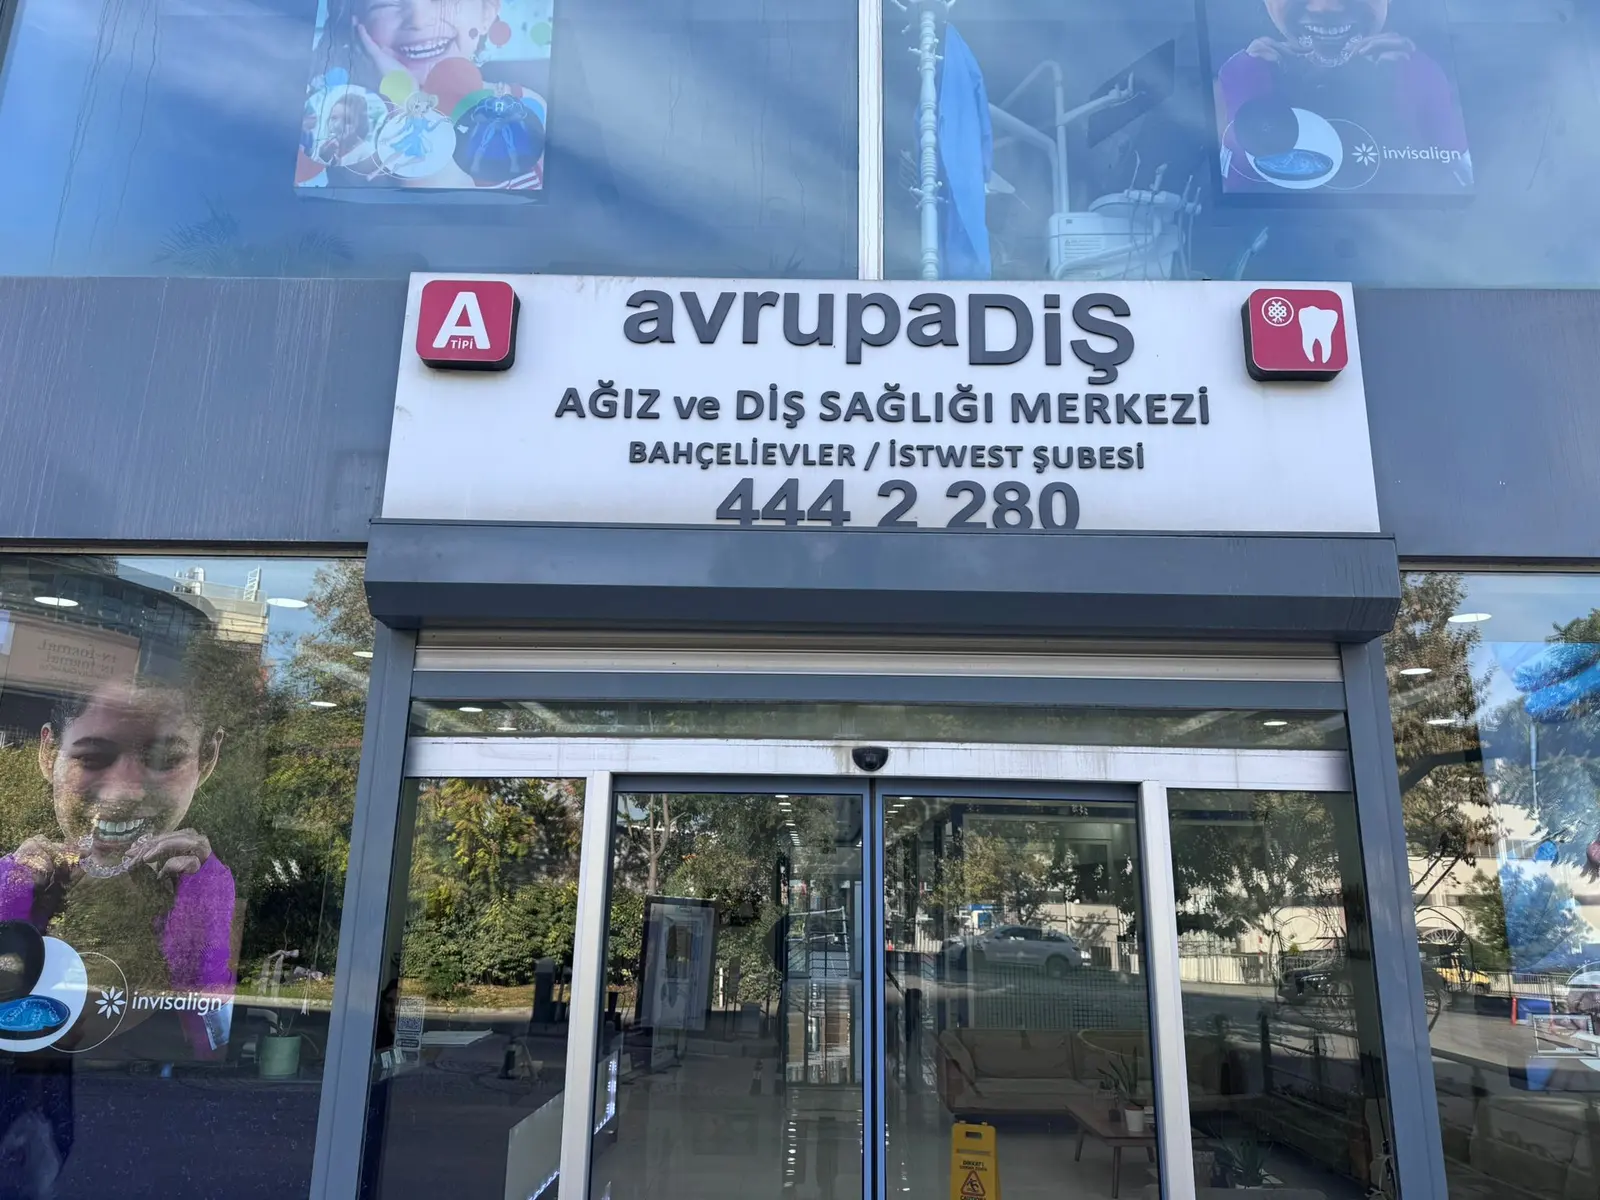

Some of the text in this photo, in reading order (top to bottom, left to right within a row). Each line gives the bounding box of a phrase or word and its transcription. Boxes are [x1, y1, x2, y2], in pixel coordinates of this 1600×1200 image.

[1382, 146, 1461, 164] invisalign
[432, 291, 491, 350] A
[450, 337, 474, 350] TİPİ
[554, 379, 1210, 430] AĞIZ ve DİŞ SAĞLIĞI MERKEZİ
[628, 437, 856, 471] BAHÇELİEVLER
[889, 438, 1024, 469] İSTWEST
[1032, 441, 1145, 475] ŞUBESİ
[715, 477, 1080, 530] 444 2 280
[131, 990, 222, 1015] invisalign
